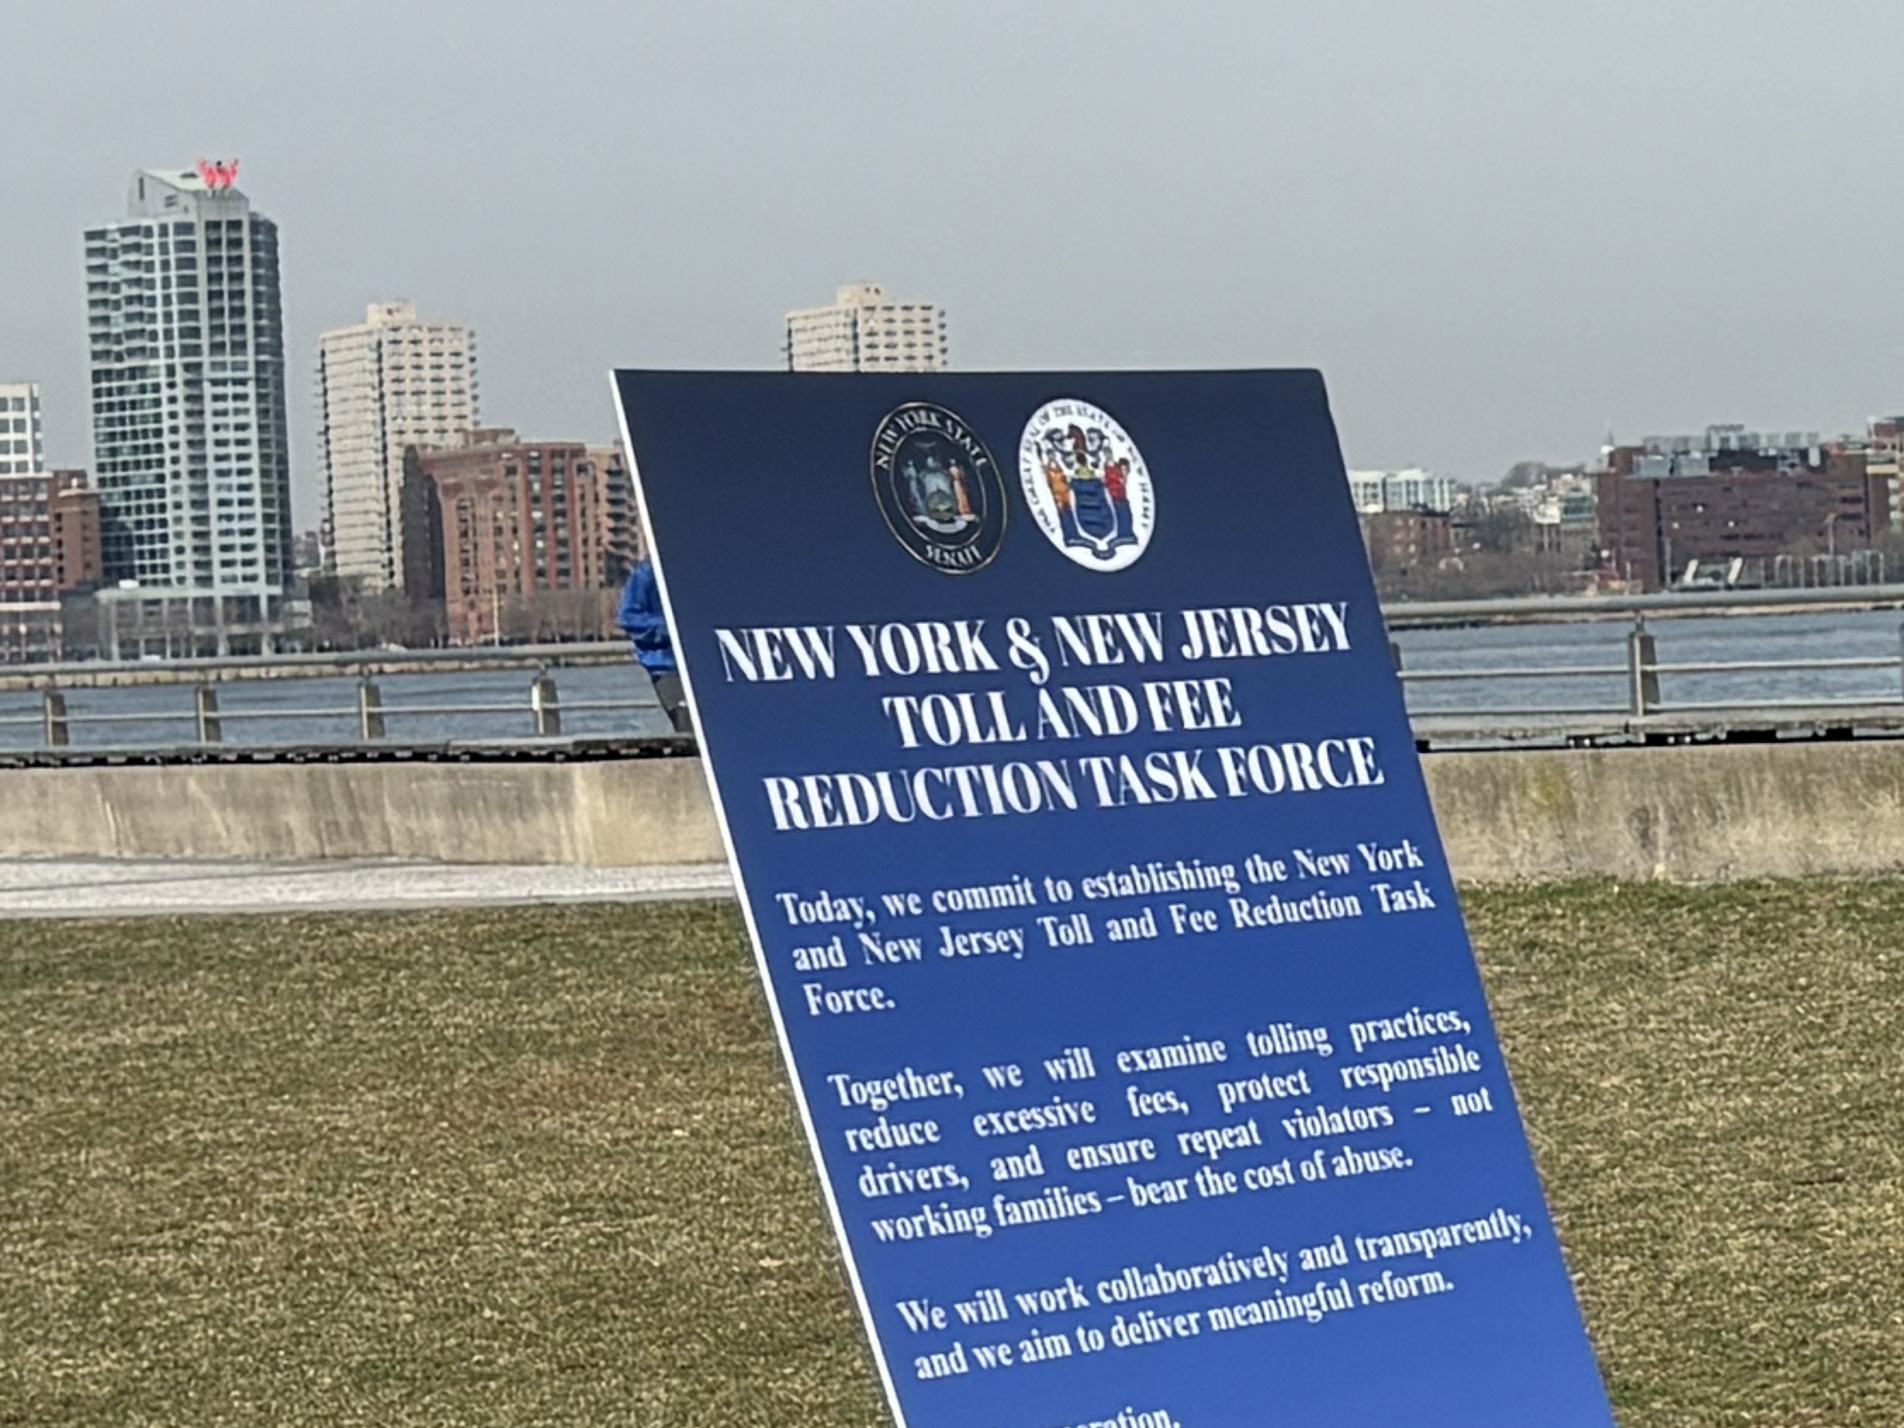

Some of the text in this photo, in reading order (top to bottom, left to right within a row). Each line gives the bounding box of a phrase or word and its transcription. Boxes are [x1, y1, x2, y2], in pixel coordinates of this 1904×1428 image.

[715, 602, 1350, 684] NEW YORK & NEW JERSEY
[882, 678, 1241, 748] TOLL AND FEE
[764, 737, 1384, 830] REDUCTION TASK FORCE
[776, 840, 1424, 934] Today, we commit to establishing the New York
[793, 880, 1435, 970] and New Jersey Toll and Fee Reduction Task
[803, 983, 895, 1016] Force.
[827, 1007, 1471, 1111] Together, we will examine tolling practices,
[845, 1044, 1481, 1152] reduce excessive fees, protect responsible
[859, 1162, 969, 1197] drivers,
[991, 1144, 1044, 1180] and
[1067, 1139, 1155, 1170] ensure
[1177, 1119, 1262, 1160] repeat
[1282, 1105, 1394, 1138] violators
[1451, 1087, 1493, 1116] not
[871, 1203, 992, 1241] working
[993, 1186, 1102, 1226] families
[1127, 1177, 1188, 1206] bear
[1195, 1166, 1238, 1197] the
[1244, 1159, 1295, 1190] cost
[1300, 1150, 1327, 1181] of
[1332, 1146, 1413, 1177] abuse.
[896, 1208, 1532, 1332] We will work collaboratively and transparently,
[915, 1270, 1454, 1379] and we aim to deliver meaningful reform.
